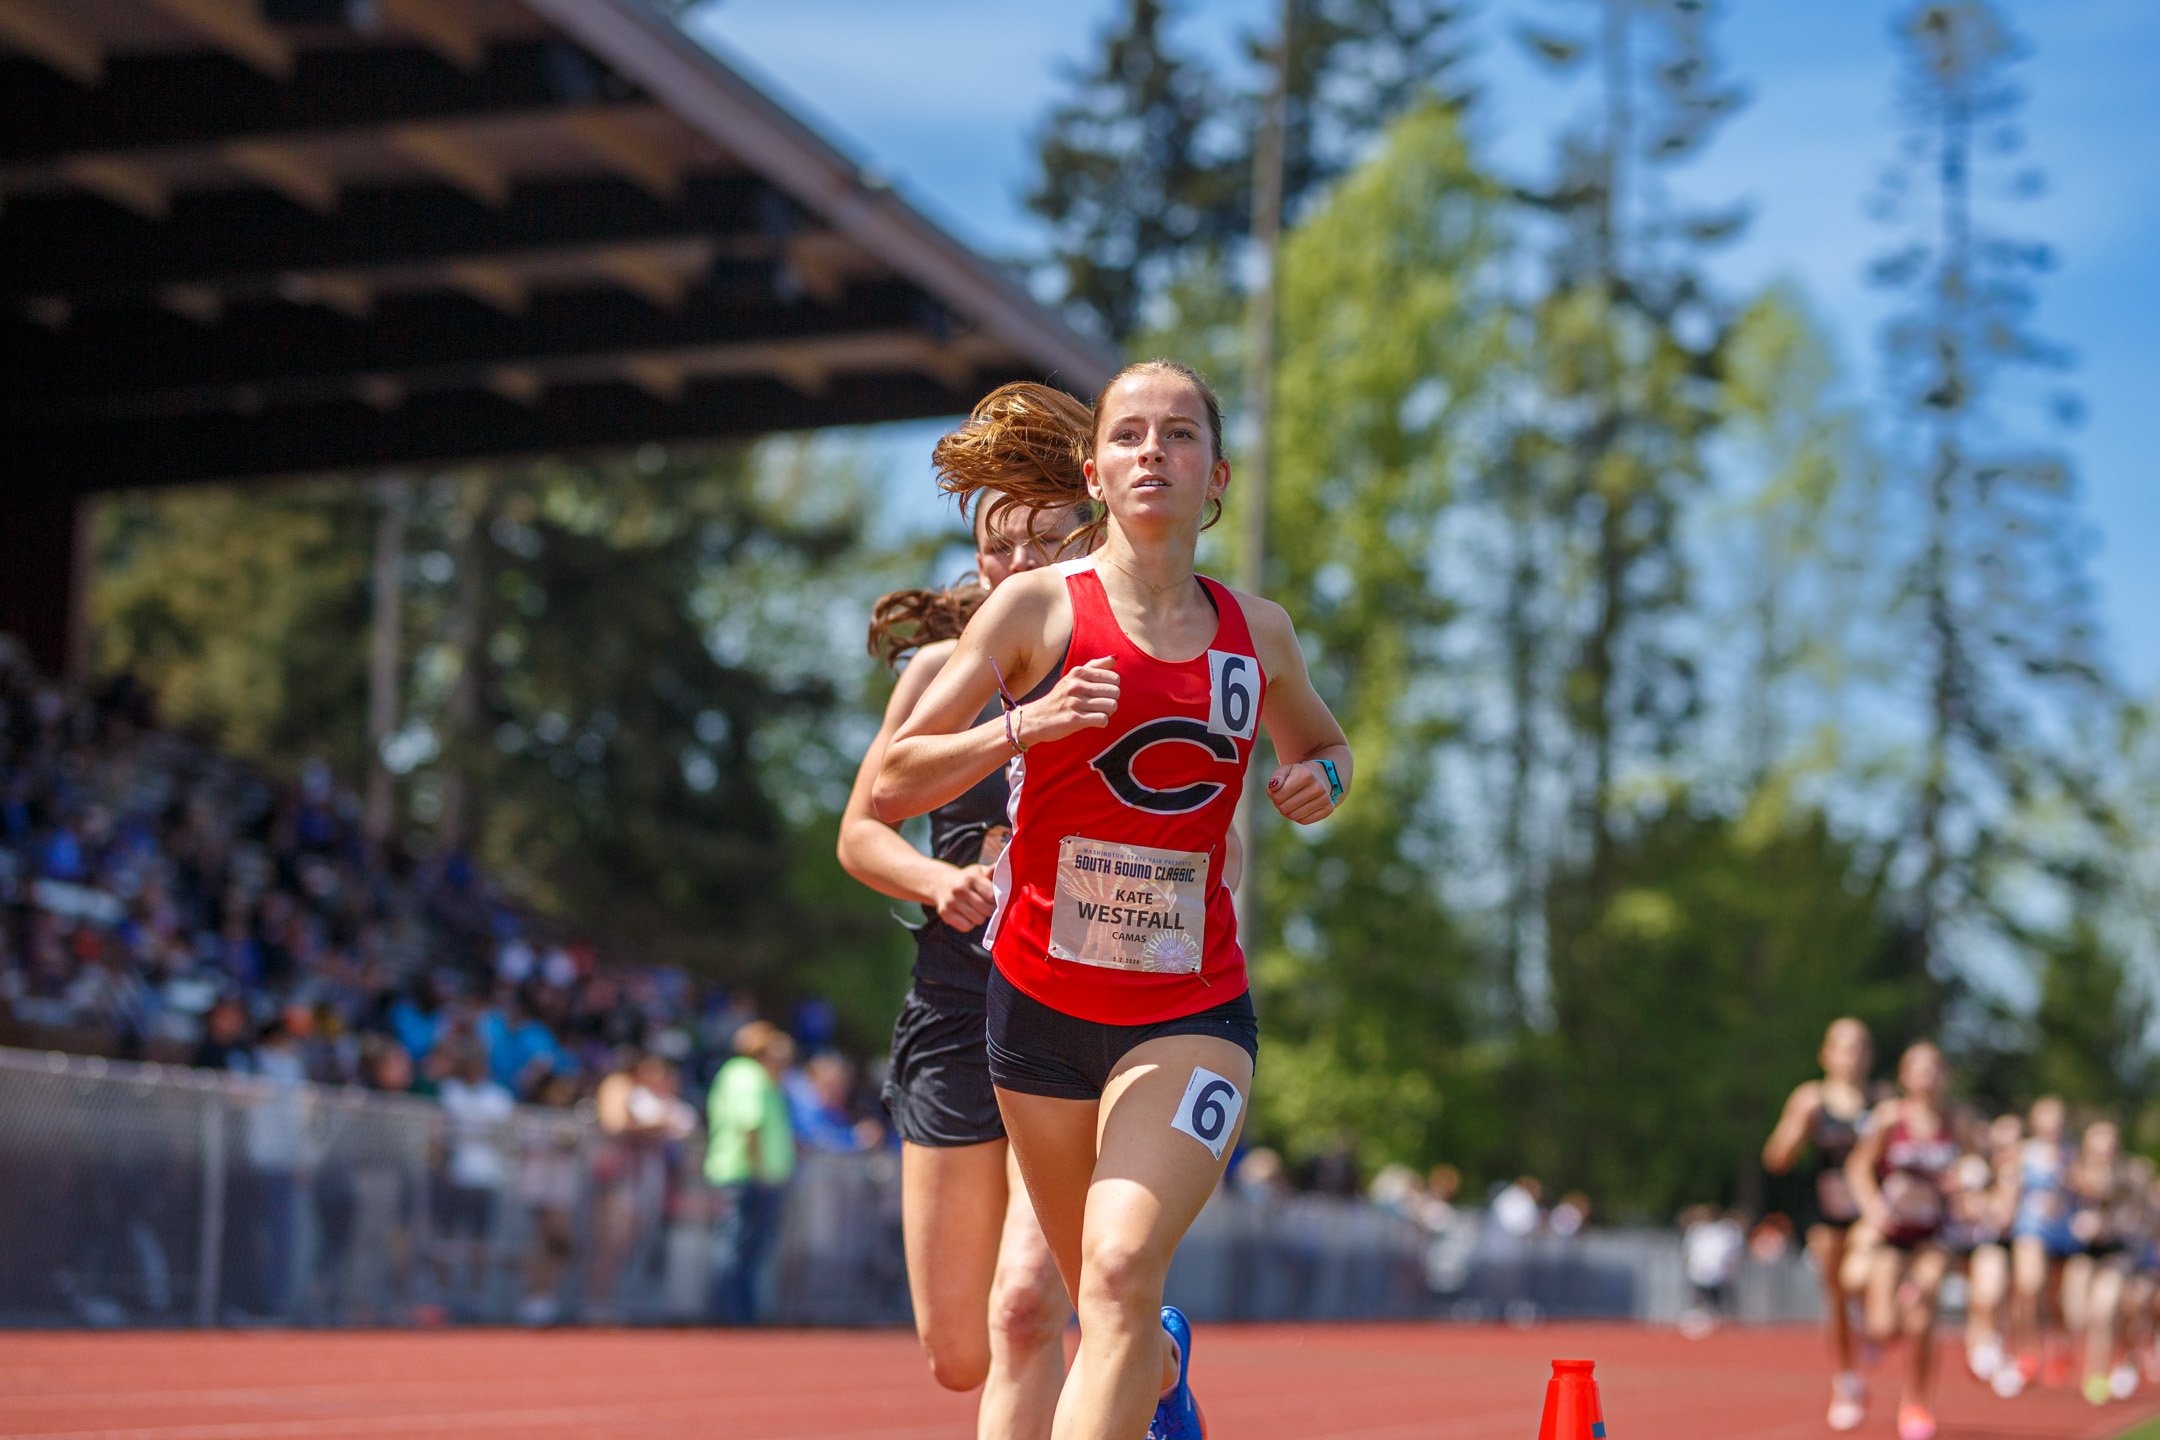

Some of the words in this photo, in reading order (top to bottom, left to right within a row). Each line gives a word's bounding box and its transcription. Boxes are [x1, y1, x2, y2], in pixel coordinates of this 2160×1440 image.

[1221, 656, 1250, 732] 6
[1087, 716, 1239, 815] C
[1075, 854, 1111, 874] SOUTH
[1115, 861, 1152, 880] SOUND
[1154, 866, 1195, 882] CLASSIC
[1083, 847, 1124, 859] WASHINGTON
[1127, 854, 1146, 862] STATE
[1149, 857, 1162, 865] FAIR
[1116, 889, 1153, 904] KATE
[1078, 901, 1185, 930] WESTFALL
[1112, 931, 1147, 943] CAMAS
[1192, 1080, 1235, 1141] 6
